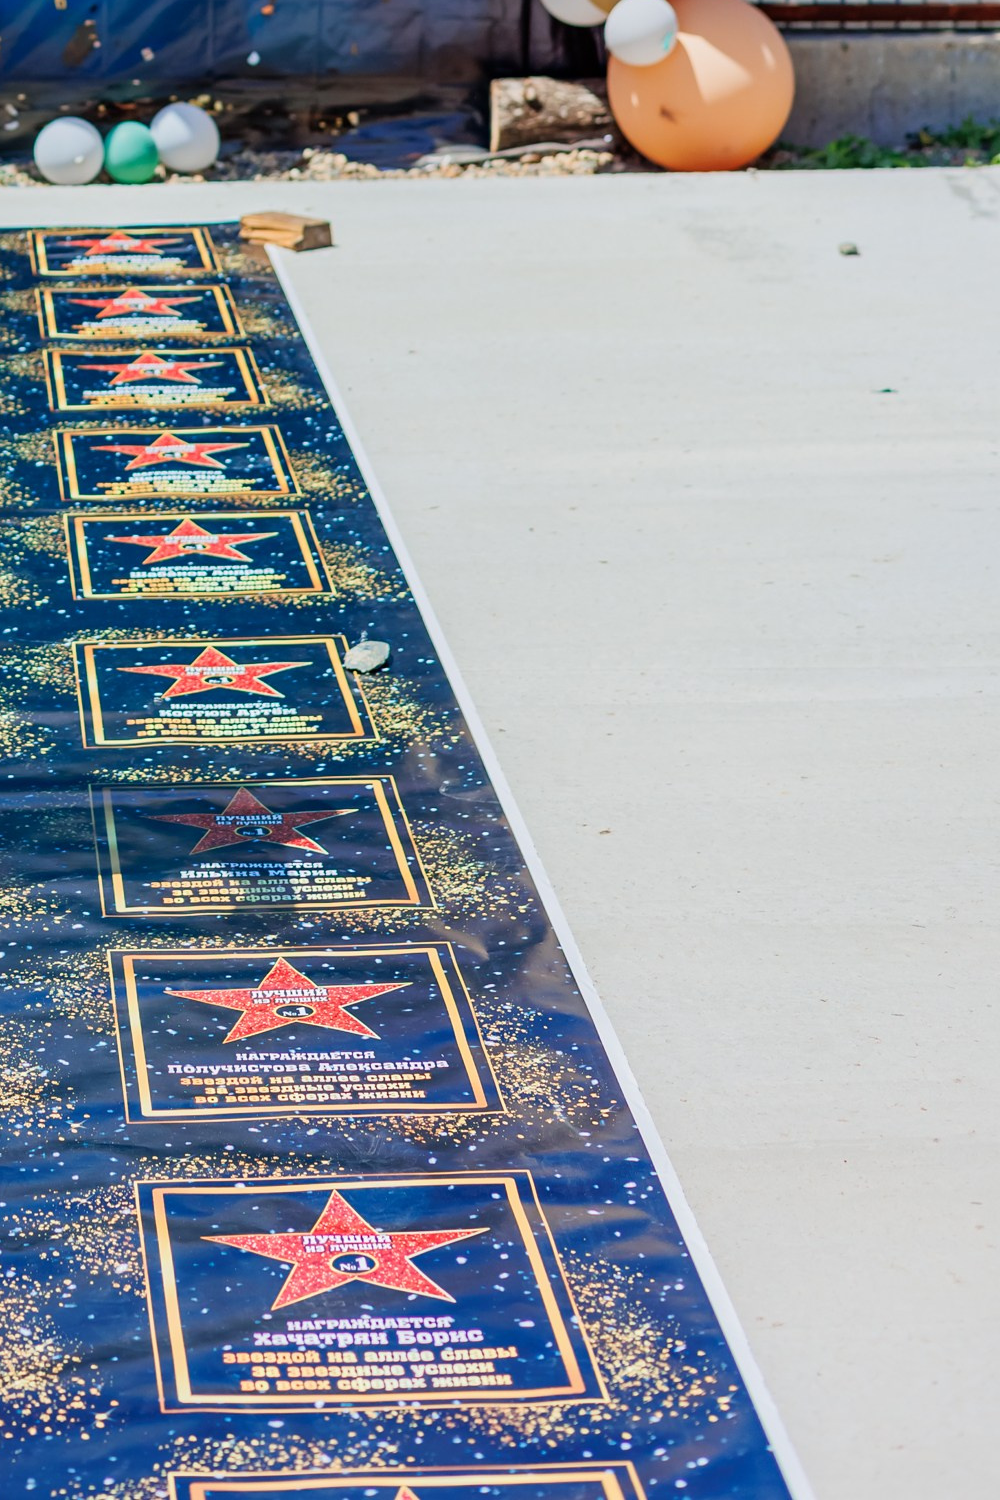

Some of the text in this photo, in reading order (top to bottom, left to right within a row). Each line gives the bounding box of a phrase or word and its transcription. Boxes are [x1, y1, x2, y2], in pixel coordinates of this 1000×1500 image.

[318, 1059, 449, 1072] Александра
[253, 1328, 484, 1348] Хачатрян Борис
[222, 1347, 518, 1364] звездой на аллее славы
[252, 1361, 495, 1378] за звездные успехи
[241, 1373, 513, 1392] во всех сферах жизни
